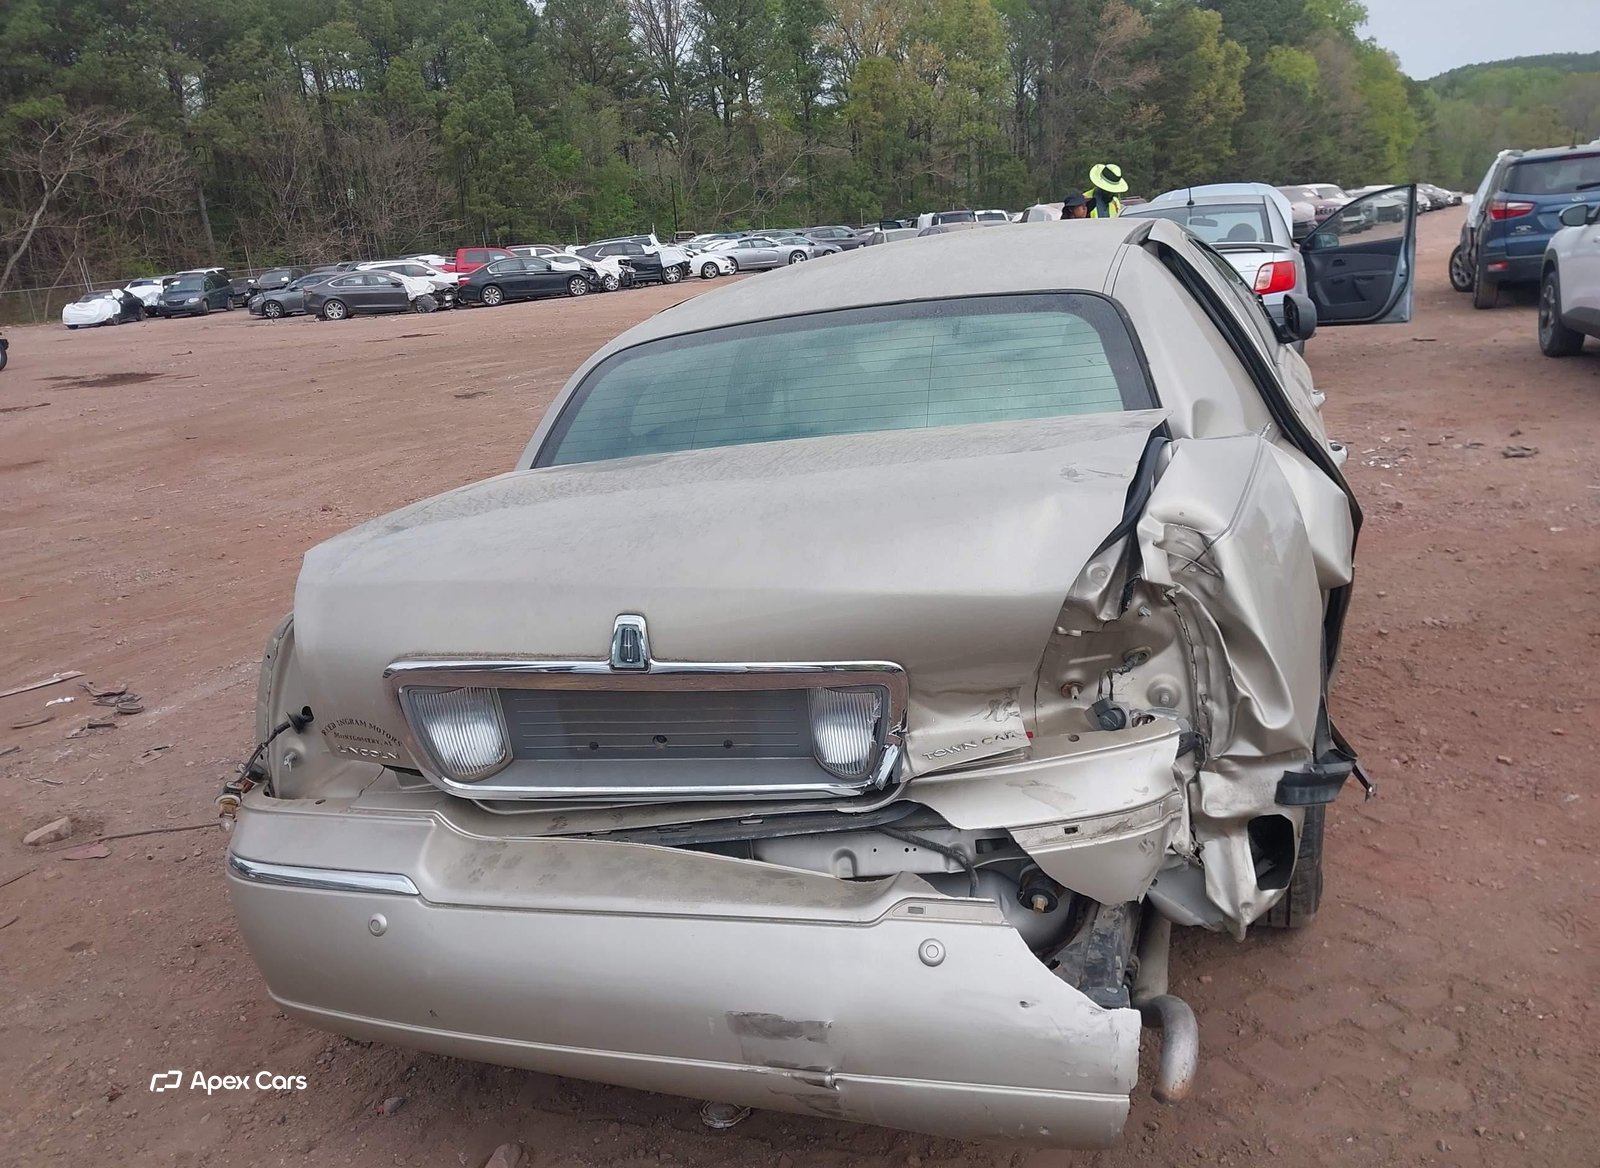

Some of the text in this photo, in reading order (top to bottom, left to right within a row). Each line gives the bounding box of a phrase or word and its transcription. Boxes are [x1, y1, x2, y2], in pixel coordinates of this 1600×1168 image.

[337, 718, 367, 728] INGRAM
[368, 723, 403, 747] MOTORS
[922, 730, 1018, 760] TOWN CAR
